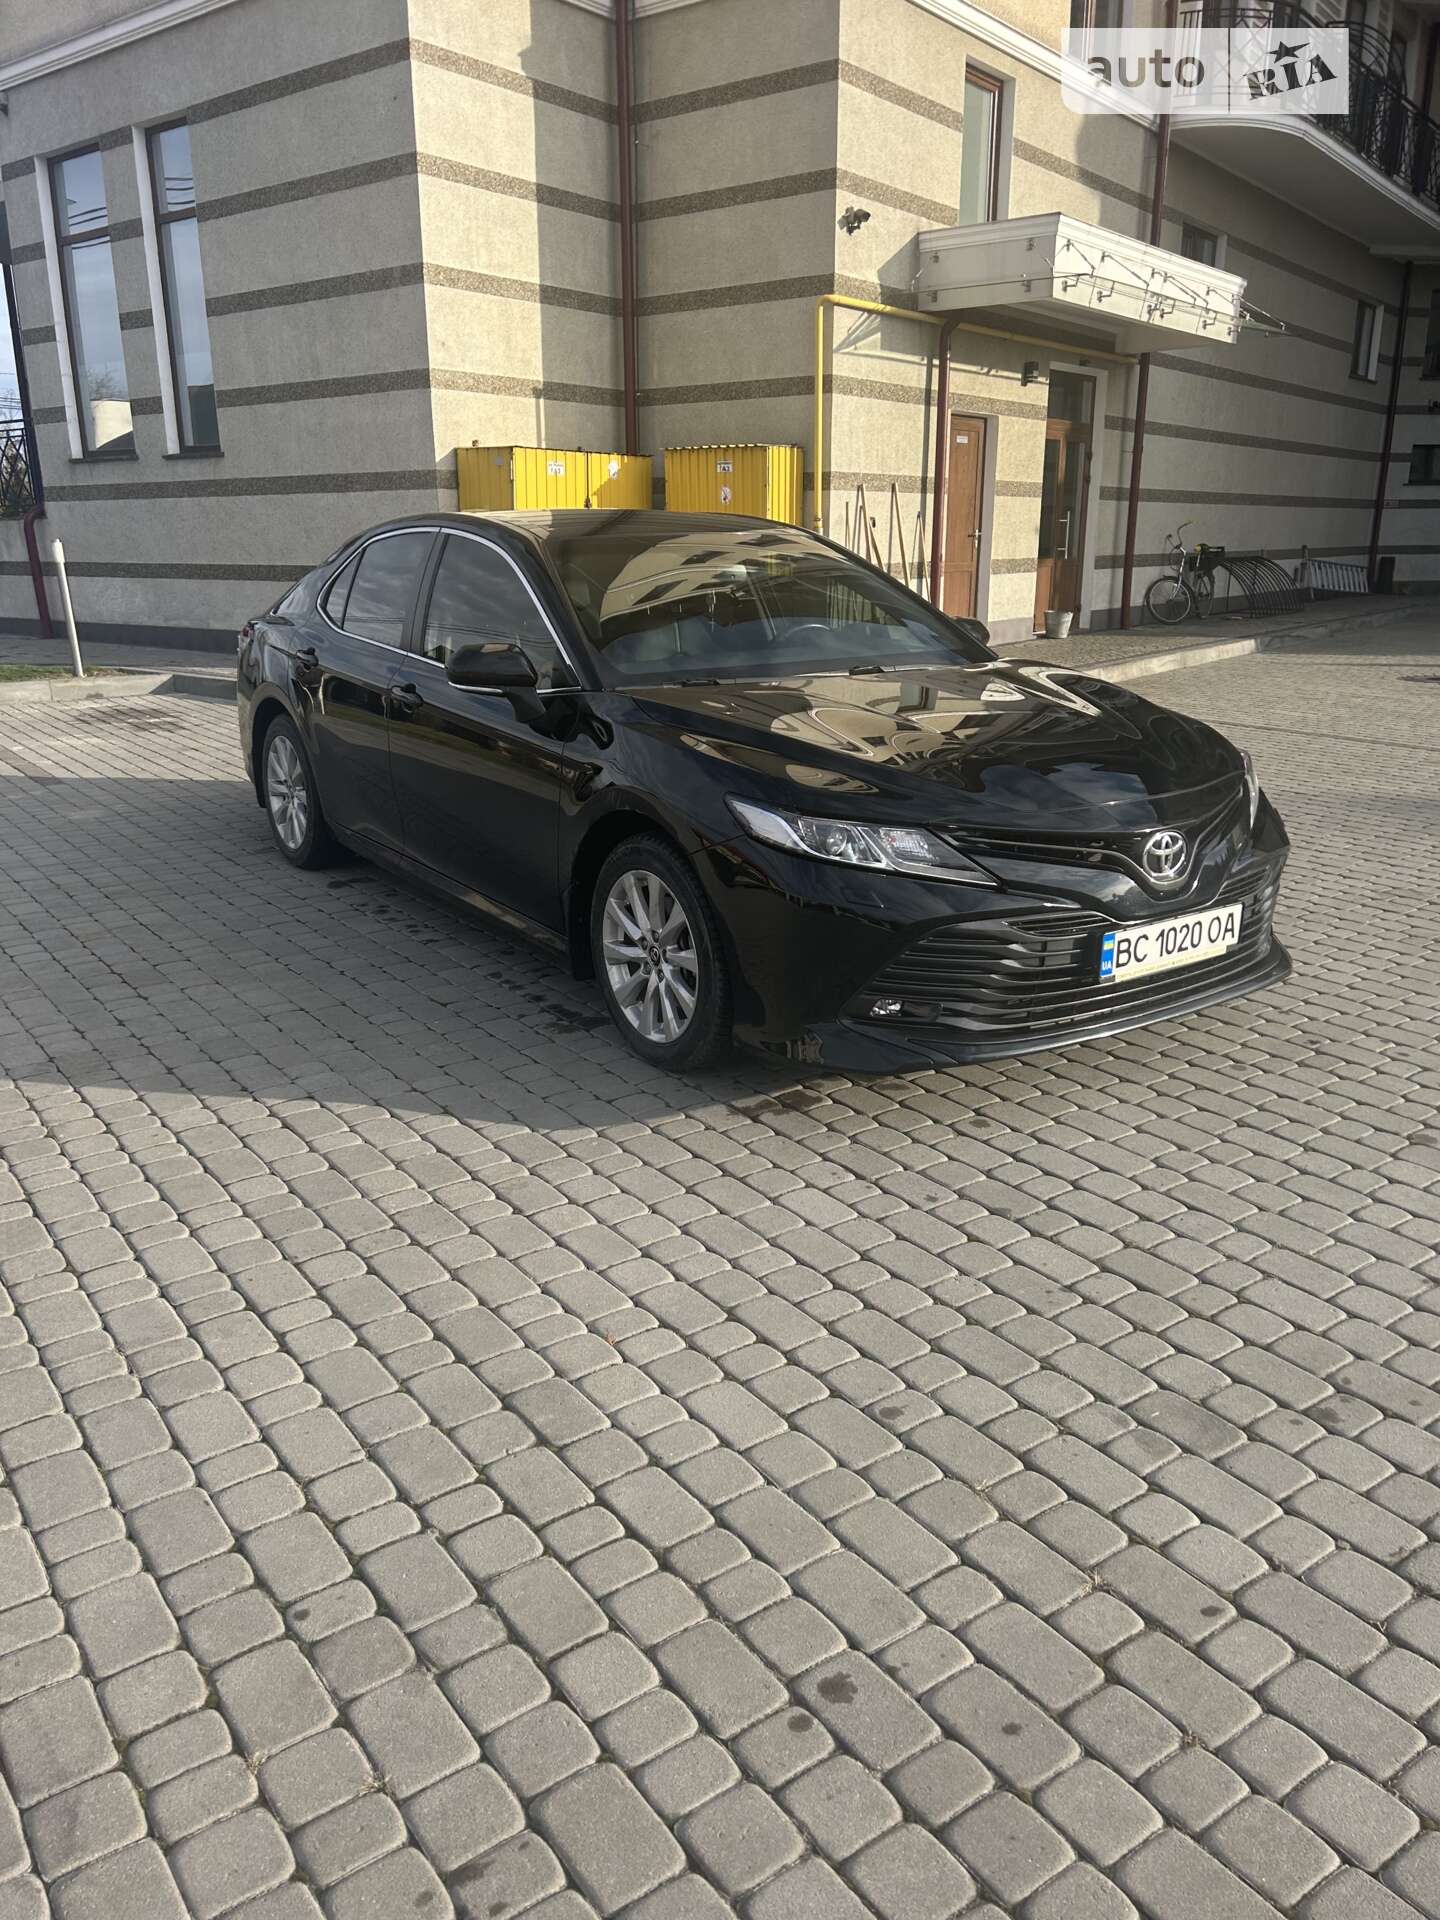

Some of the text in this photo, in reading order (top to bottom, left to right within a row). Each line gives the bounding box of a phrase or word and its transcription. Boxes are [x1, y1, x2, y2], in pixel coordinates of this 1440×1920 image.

[1115, 934, 1149, 969] BC
[1155, 921, 1203, 957] 1020
[1207, 912, 1235, 944] OA
[1101, 960, 1112, 971] UA
